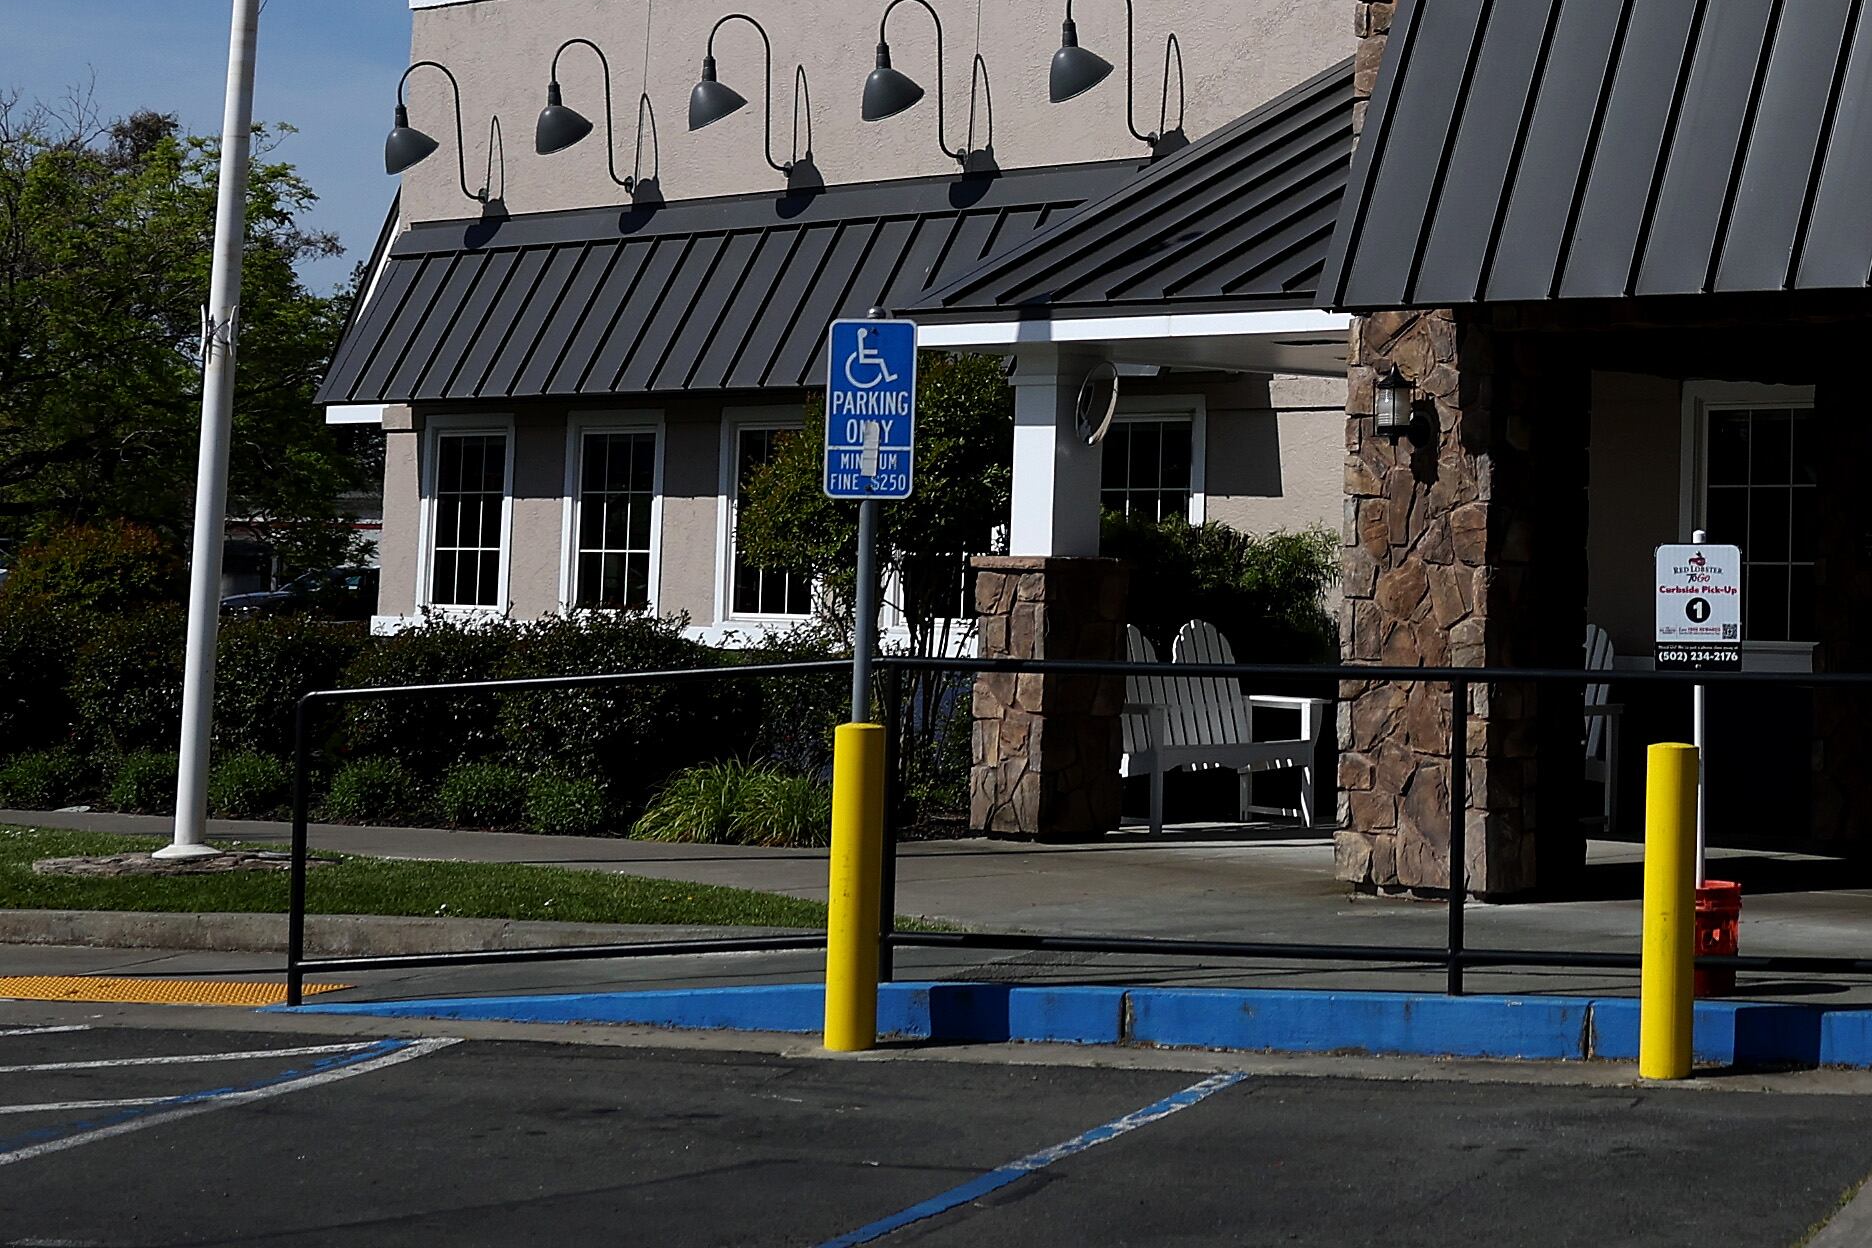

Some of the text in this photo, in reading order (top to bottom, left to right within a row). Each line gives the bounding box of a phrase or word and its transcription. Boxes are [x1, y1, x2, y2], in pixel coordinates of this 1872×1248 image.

[833, 391, 908, 416] PARKING
[840, 453, 897, 470] MINUM
[830, 474, 906, 491] FINE $250
[1659, 585, 1738, 595] Curbside Pick-Up
[1693, 601, 1703, 619] 1
[1658, 651, 1739, 662] (502) 234-2176
